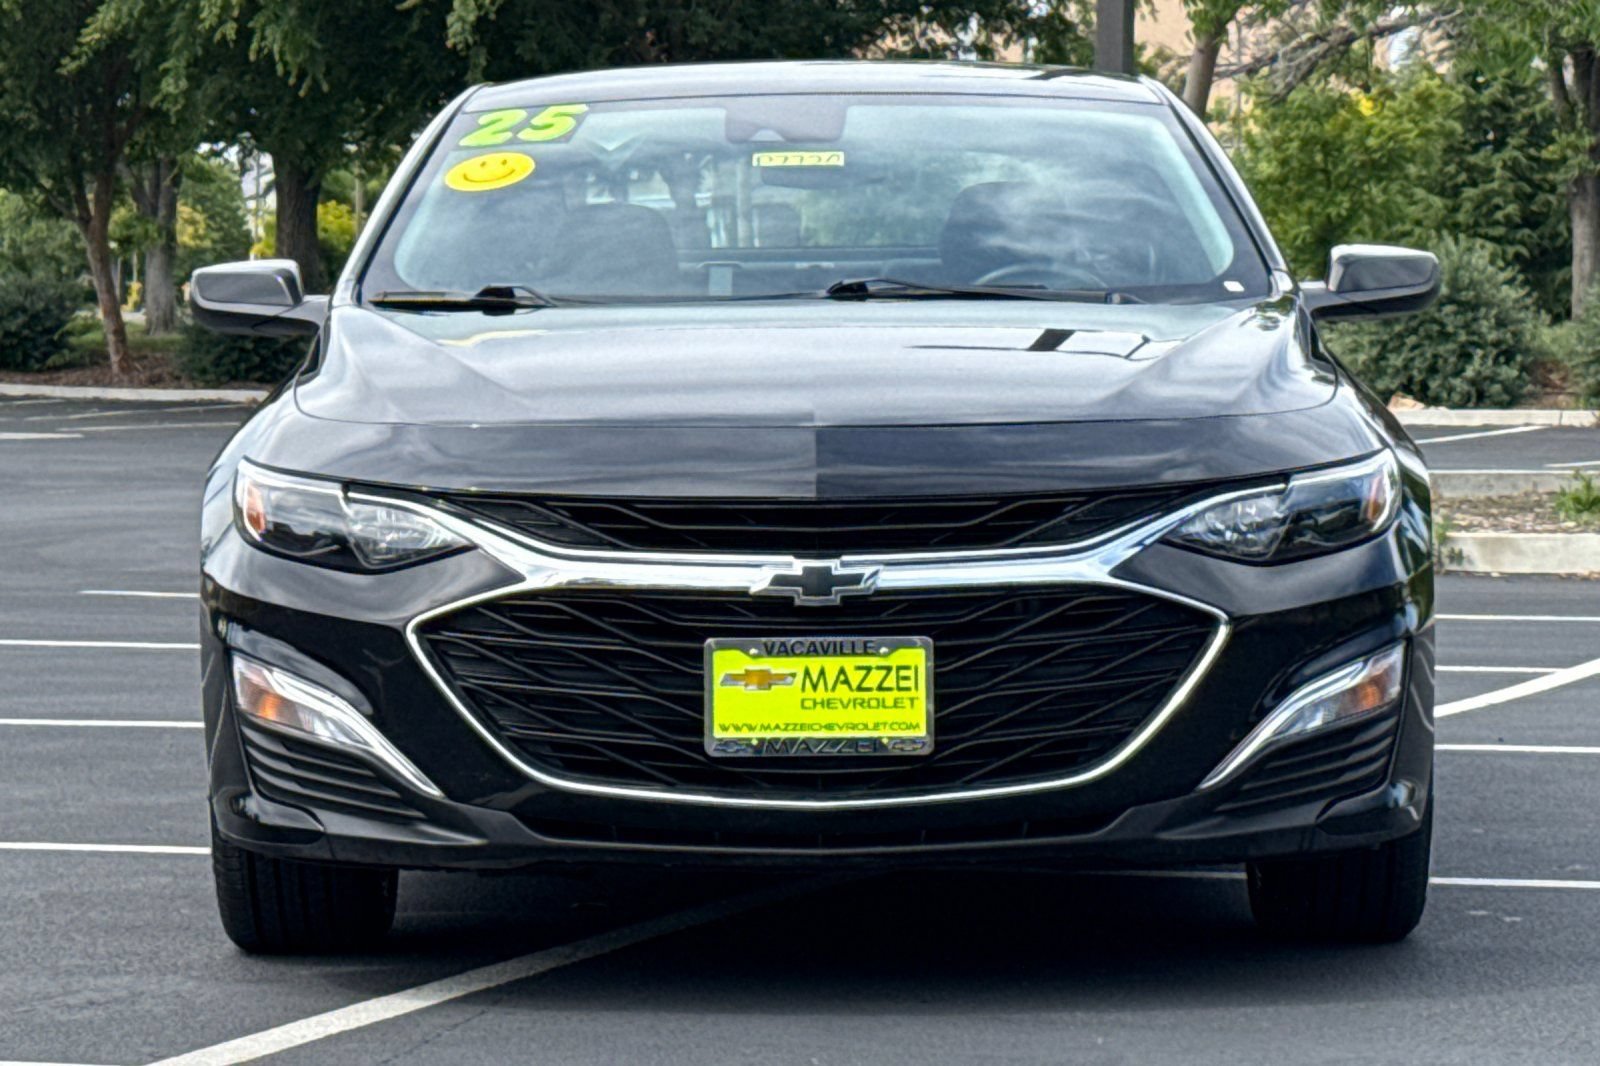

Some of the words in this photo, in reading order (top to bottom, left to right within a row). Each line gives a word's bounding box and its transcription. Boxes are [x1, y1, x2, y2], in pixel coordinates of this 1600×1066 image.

[458, 103, 589, 147] 25
[763, 640, 877, 656] VACAVILLE
[801, 665, 919, 692] MAZZEI
[801, 697, 919, 709] CHEVROLET
